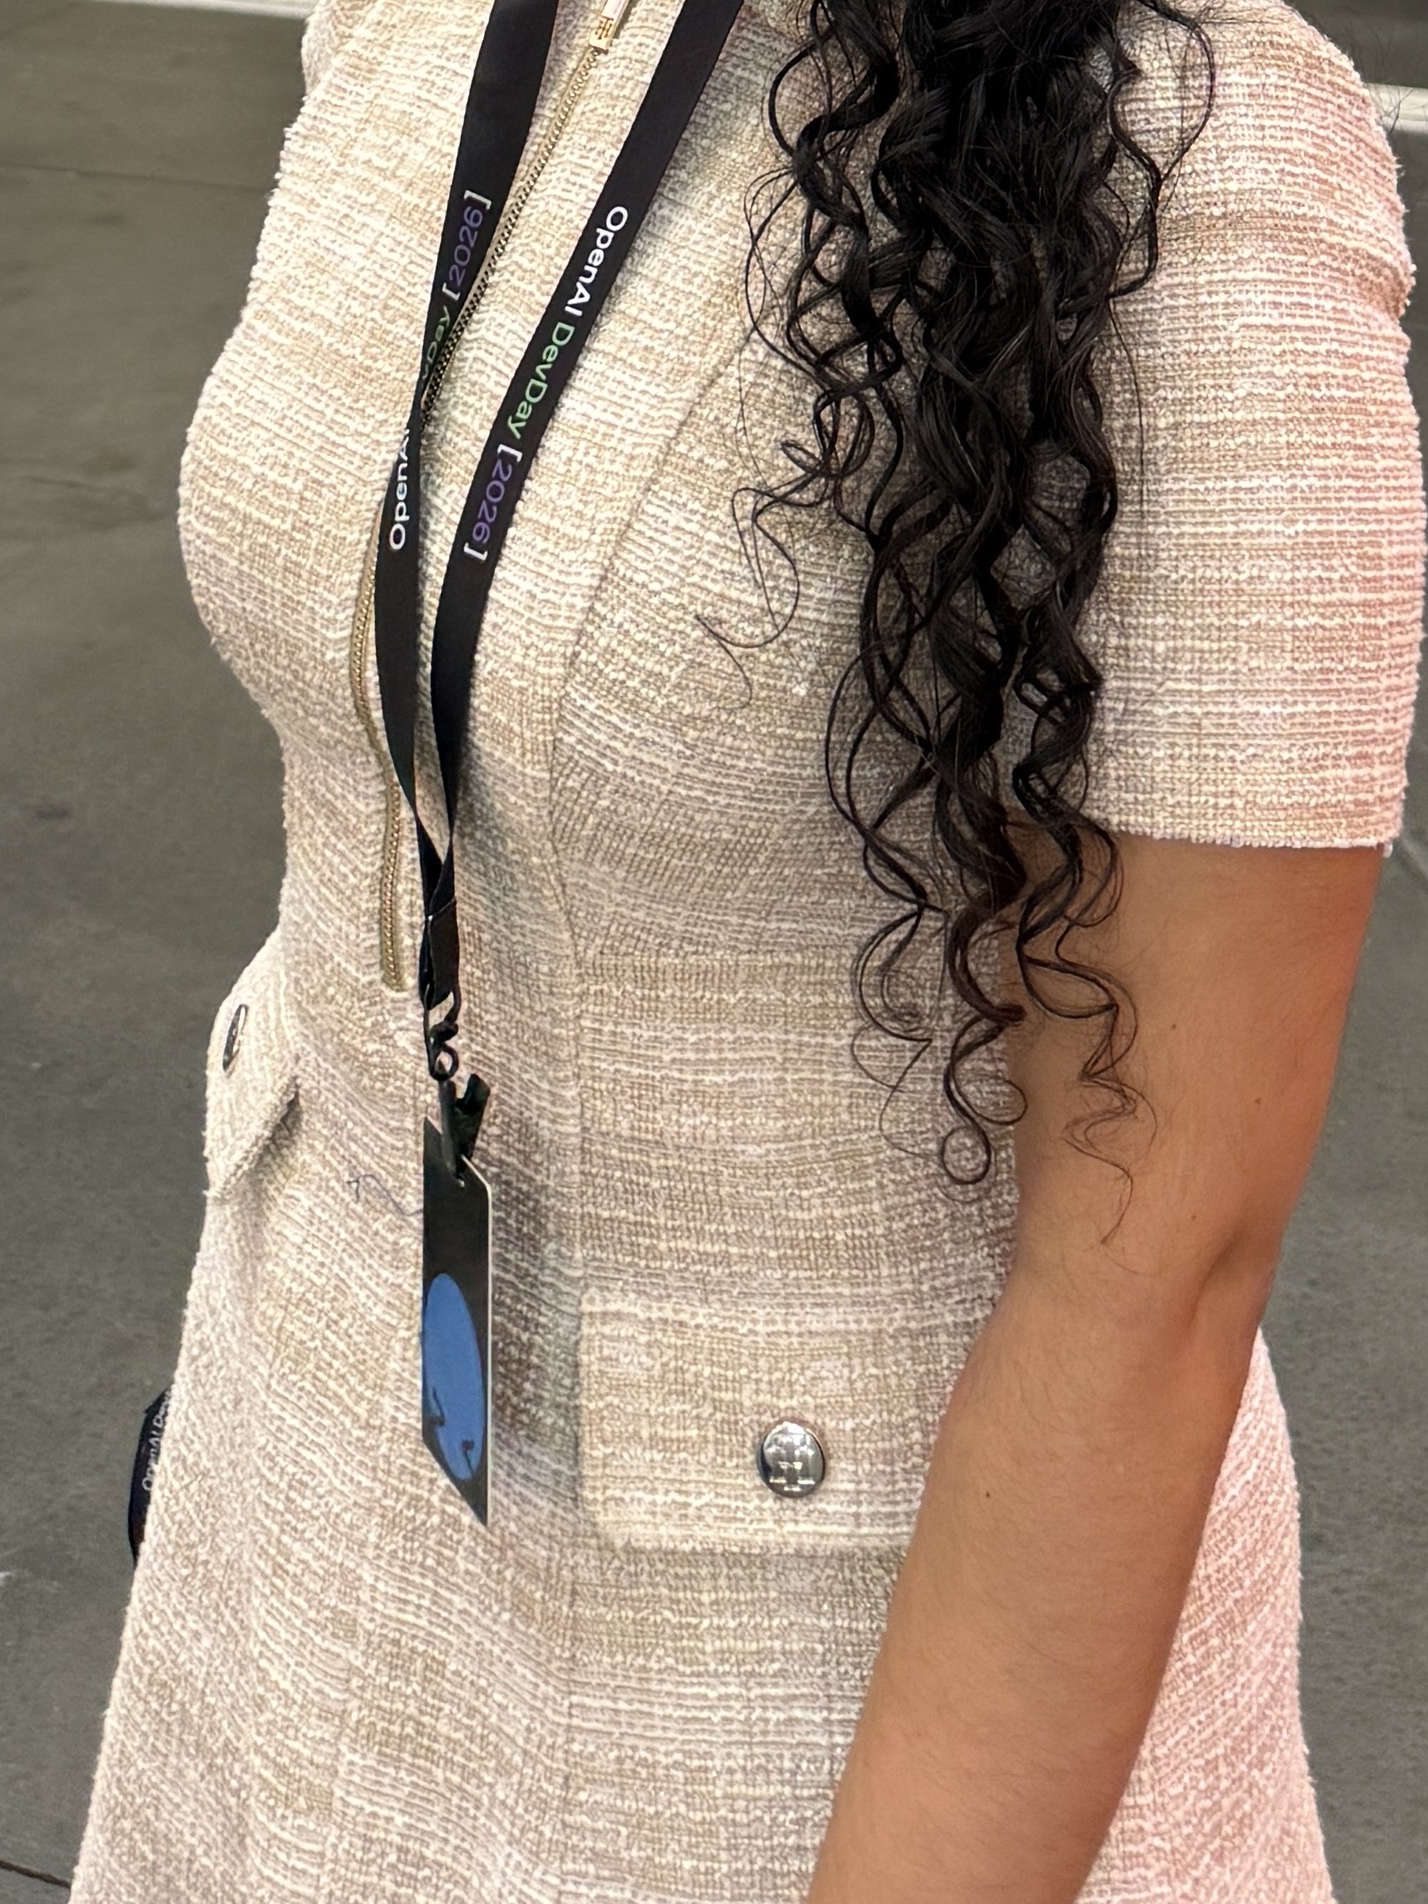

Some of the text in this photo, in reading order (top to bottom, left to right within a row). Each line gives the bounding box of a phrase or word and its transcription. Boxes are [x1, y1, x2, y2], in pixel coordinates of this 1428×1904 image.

[442, 190, 492, 301] [2026]
[463, 206, 629, 561] OpenAI DevDay [2026]
